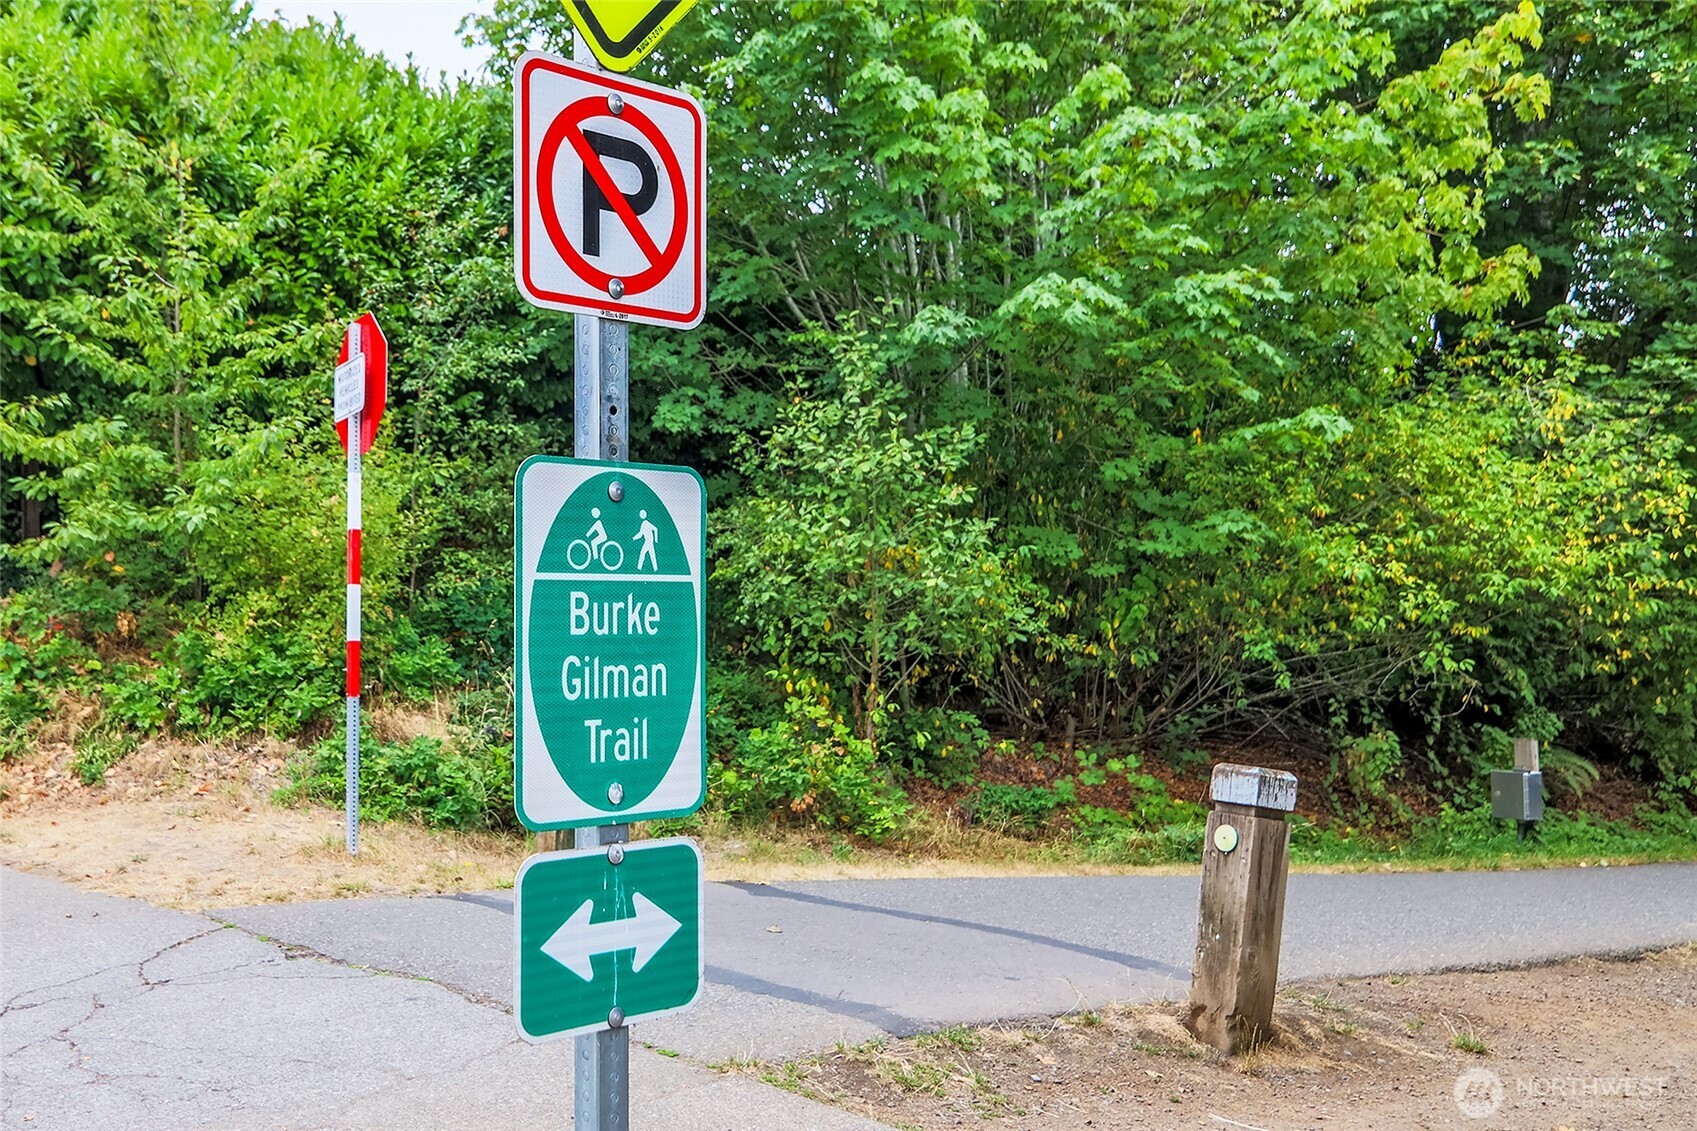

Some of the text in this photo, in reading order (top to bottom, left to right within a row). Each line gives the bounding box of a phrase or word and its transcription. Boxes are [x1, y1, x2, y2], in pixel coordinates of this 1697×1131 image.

[583, 129, 658, 257] P
[569, 590, 661, 636] Burke
[561, 654, 668, 701] Gilman
[584, 716, 649, 763] Trail
